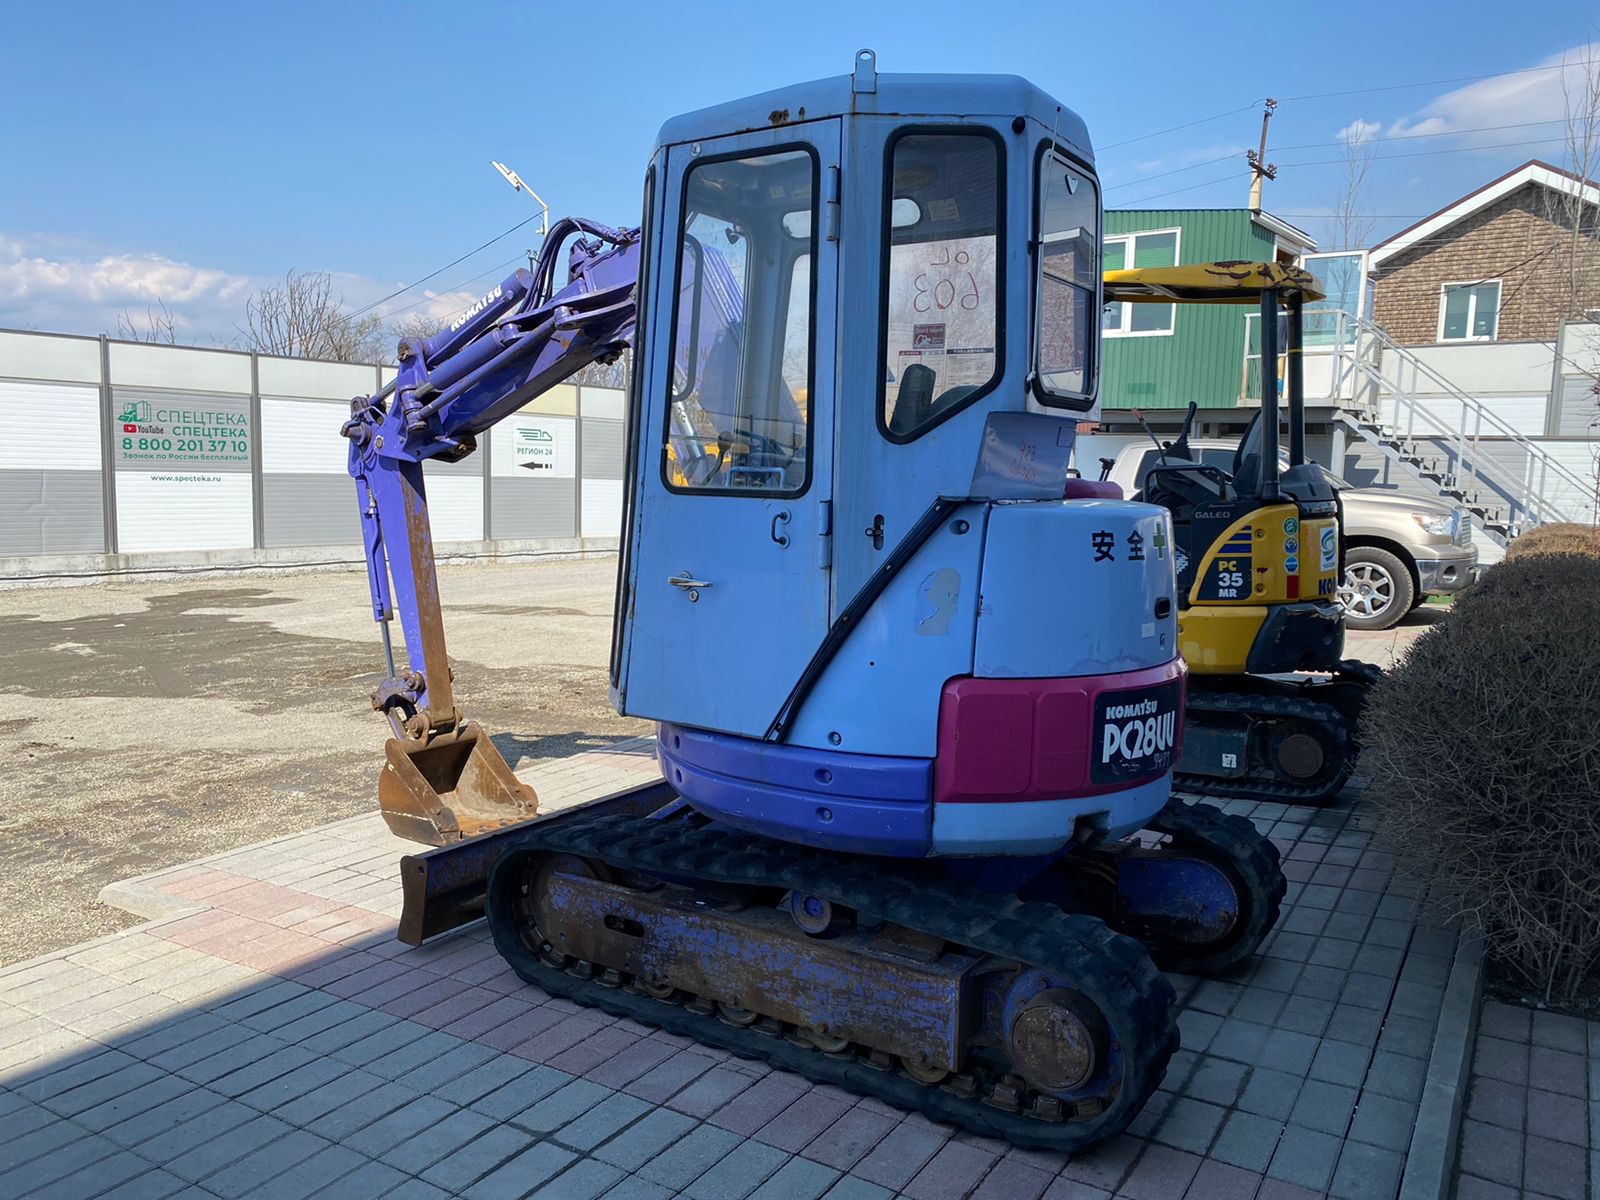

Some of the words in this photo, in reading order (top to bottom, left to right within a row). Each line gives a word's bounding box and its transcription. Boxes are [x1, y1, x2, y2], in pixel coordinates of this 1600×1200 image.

[156, 409, 248, 426] СПЕЦТЕКА
[137, 424, 165, 435] YouTube
[172, 425, 248, 439] СПЕЦТЕКА
[122, 437, 133, 451] 8
[138, 438, 172, 451] 800
[177, 439, 204, 452] 201
[208, 440, 227, 453] 37
[232, 440, 248, 453] 10
[517, 447, 544, 456] РЕГИОН
[545, 448, 553, 456] 24
[123, 452, 154, 460] Звонок
[169, 453, 199, 461] России
[201, 453, 249, 461] бесплатный
[151, 474, 222, 483] www.specteka.ru
[1195, 511, 1231, 519] GALEO
[1091, 530, 1145, 562] 安全
[1218, 560, 1238, 572] PC
[1218, 572, 1243, 587] 35
[1218, 588, 1238, 598] MR
[1105, 699, 1158, 720] KOMATSU
[1102, 710, 1176, 764] PC28UU
